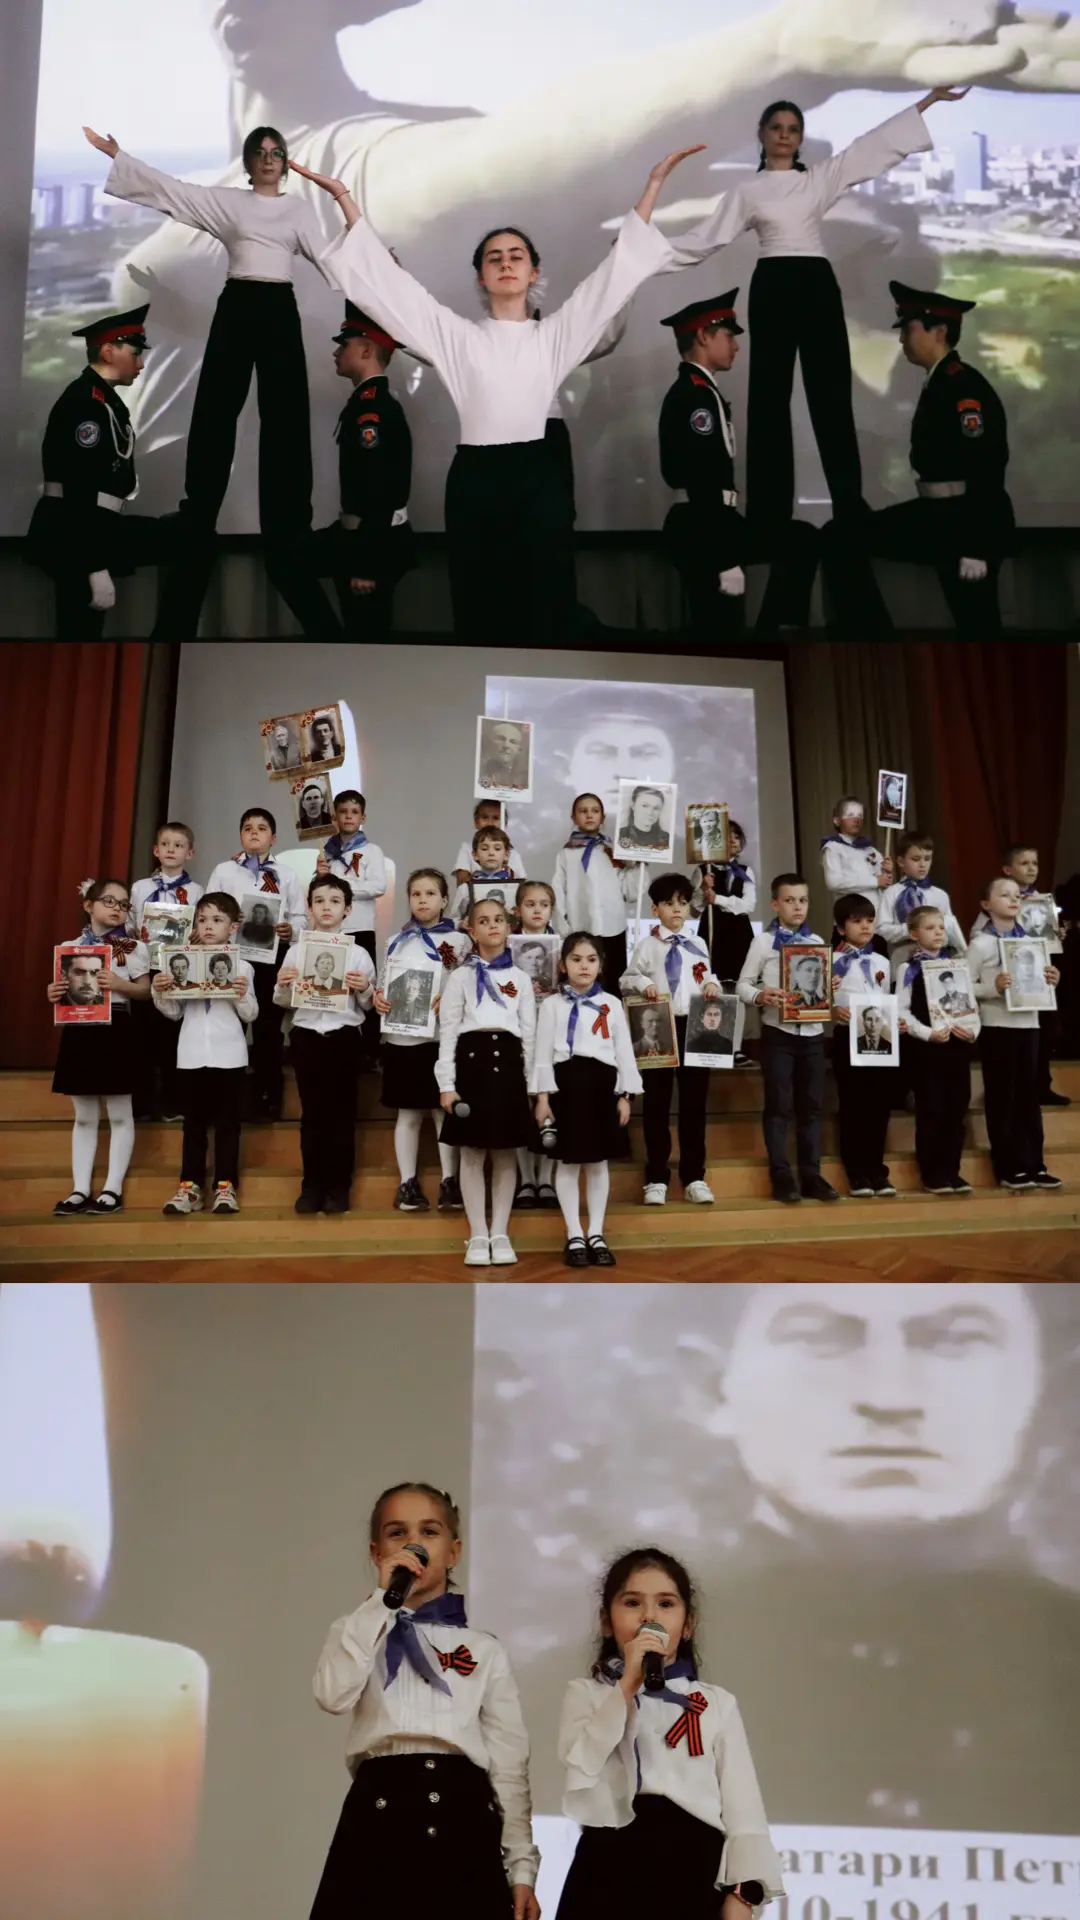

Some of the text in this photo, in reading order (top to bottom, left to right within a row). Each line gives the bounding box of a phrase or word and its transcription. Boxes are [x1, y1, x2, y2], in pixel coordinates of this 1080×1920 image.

[778, 1846, 1080, 1888] атари Пет
[778, 1894, 978, 1920] 10-1941
